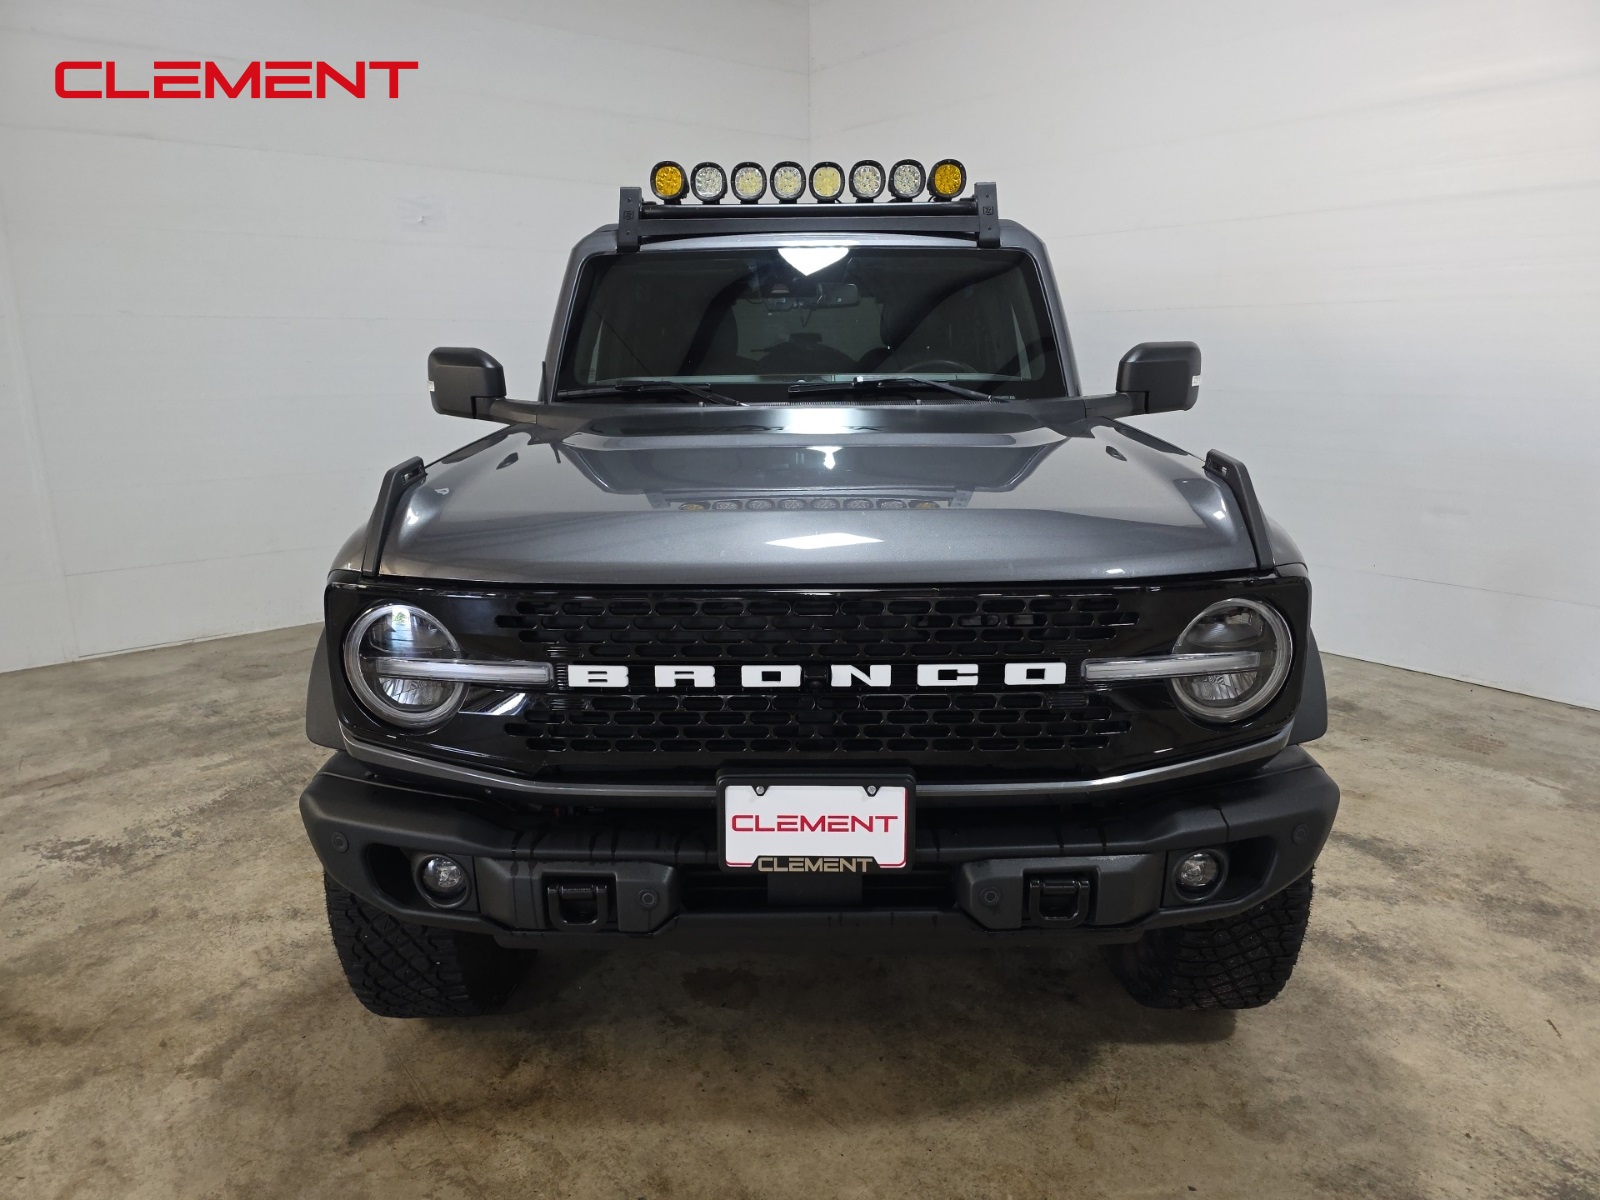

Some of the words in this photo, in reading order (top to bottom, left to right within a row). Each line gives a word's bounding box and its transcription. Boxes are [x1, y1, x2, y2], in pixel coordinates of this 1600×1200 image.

[567, 662, 1067, 688] BRONCO
[731, 814, 899, 833] CLEMENT
[757, 857, 874, 873] CLEMENT
